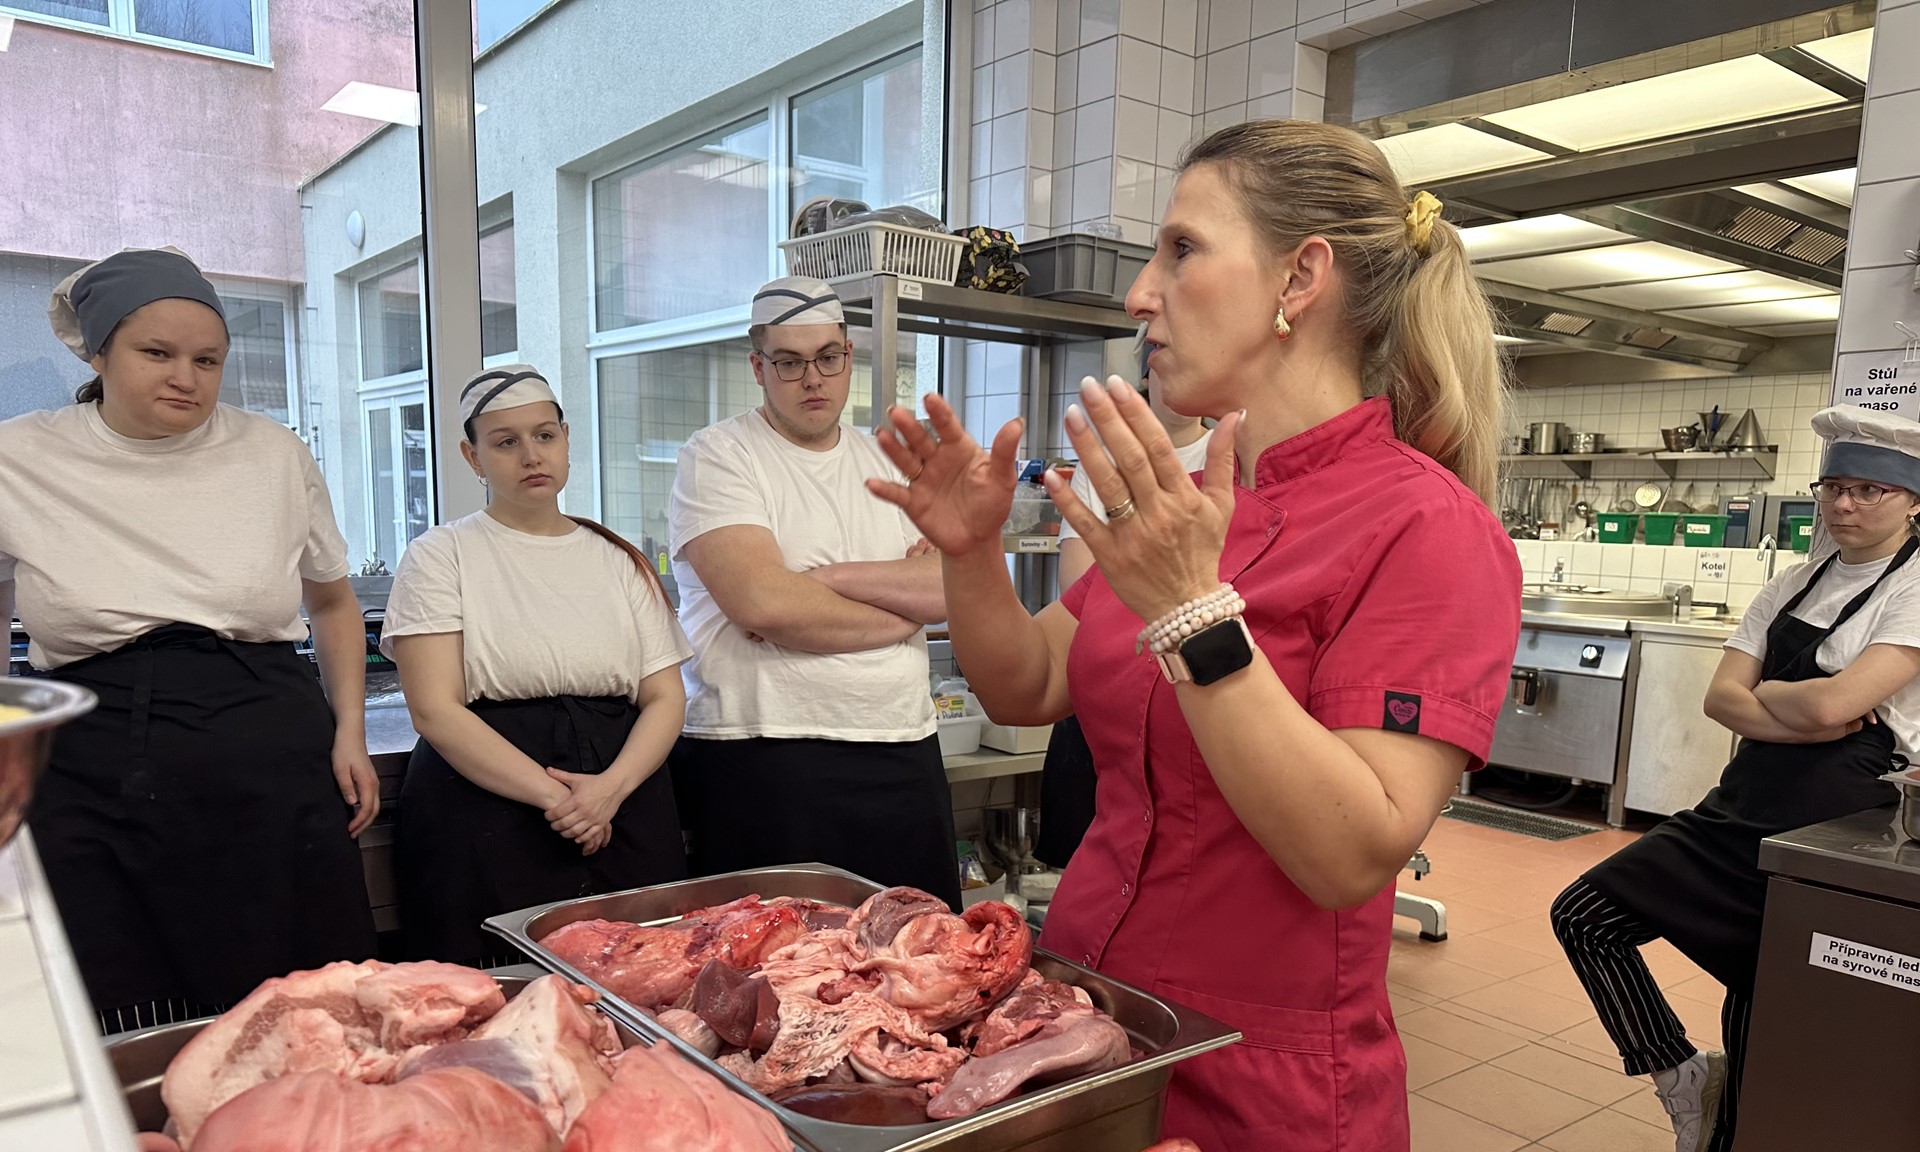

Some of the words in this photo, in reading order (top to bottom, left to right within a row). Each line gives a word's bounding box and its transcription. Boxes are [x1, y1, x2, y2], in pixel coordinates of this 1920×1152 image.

[1868, 367, 1898, 380] Stůl
[1845, 387, 1863, 397] na
[1867, 382, 1918, 396] vařené
[1701, 562, 1726, 570] Kotel
[1829, 940, 1895, 966] Přípravné
[1822, 954, 1839, 965] na
[1842, 959, 1888, 978] syrové
